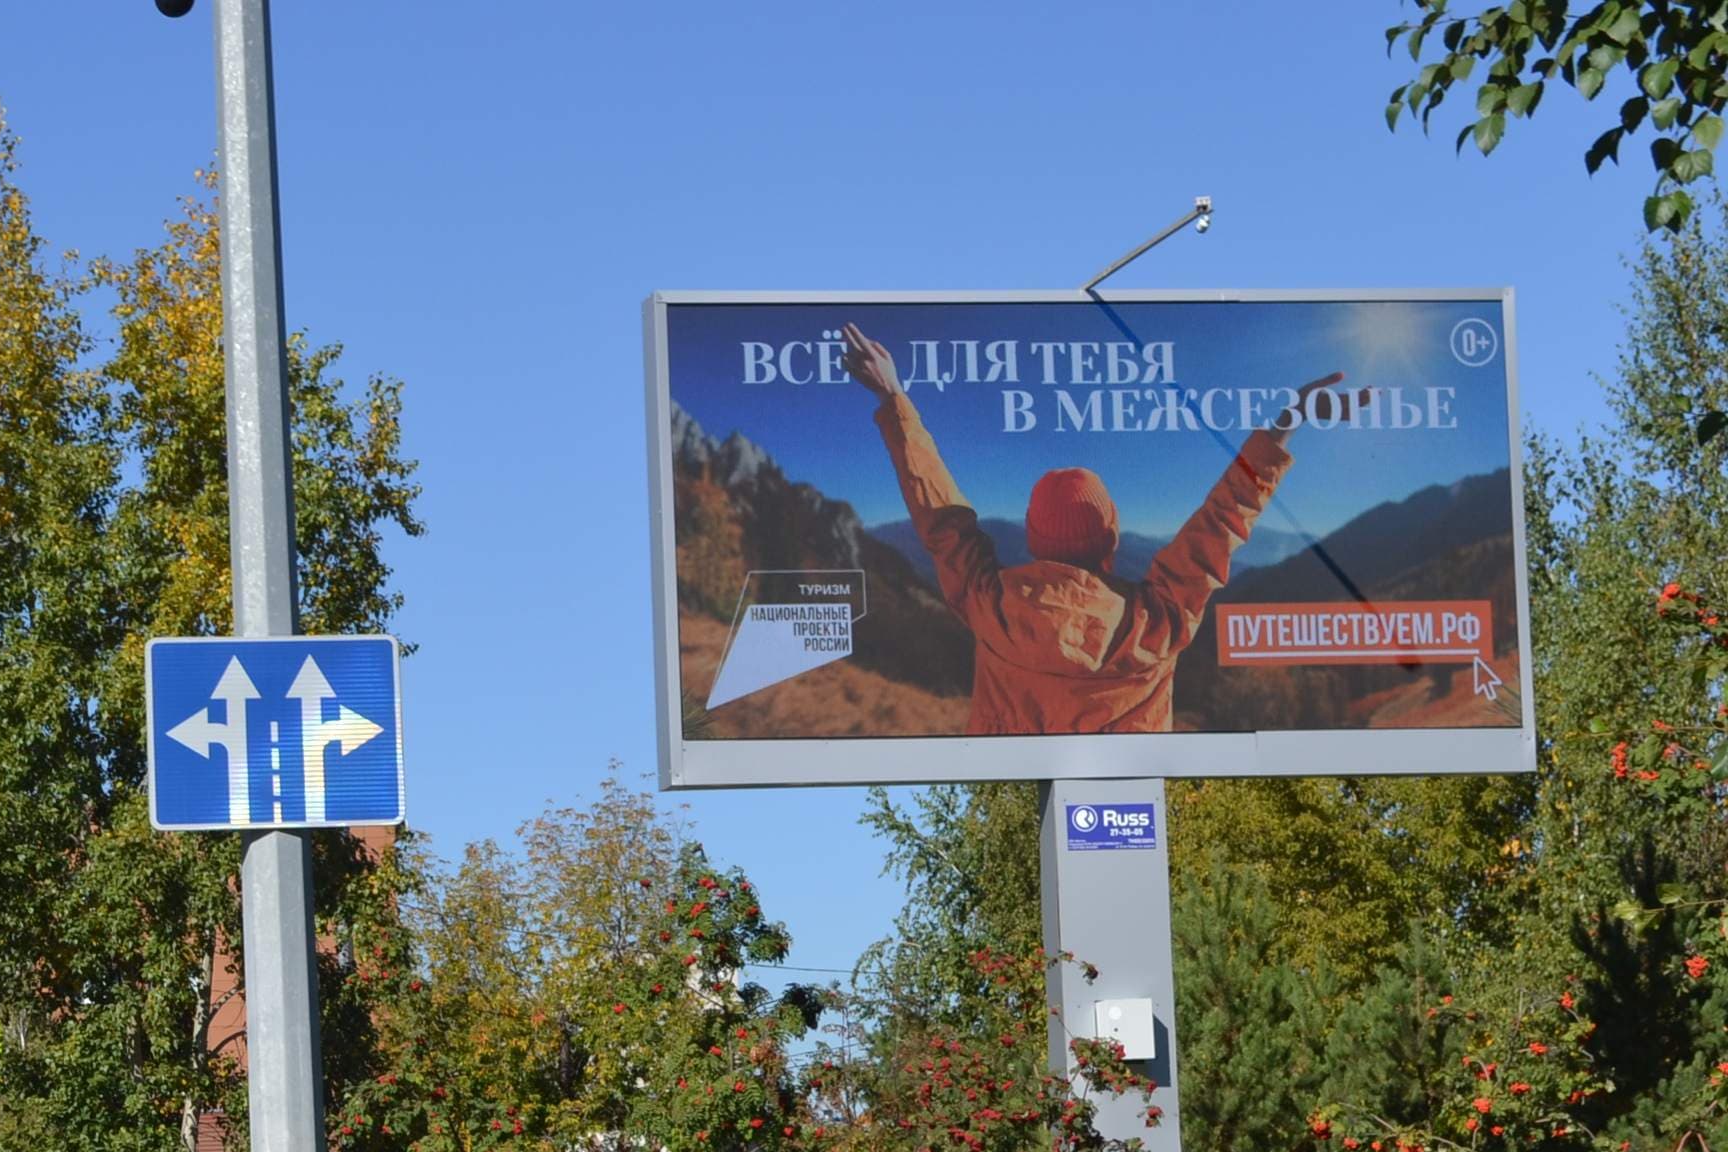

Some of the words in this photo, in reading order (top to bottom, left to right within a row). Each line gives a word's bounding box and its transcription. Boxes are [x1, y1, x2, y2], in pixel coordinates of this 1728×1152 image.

[1462, 329, 1490, 357] 0+
[741, 329, 851, 385] ВСЁ
[903, 340, 1022, 392] ДЛЯ
[1030, 340, 1177, 385] ТЕБЯ
[1002, 389, 1037, 433] В
[1055, 386, 1458, 433] МЕЖСЕЗОНЬЕ
[798, 583, 851, 596] ТУРИЗМ
[750, 605, 849, 622] НАЦИОНАЛЬНЫЕ
[793, 622, 849, 637] ПРОЕКТЫ
[1227, 612, 1481, 648] ПУТЕШЕСТВУЕМ.РФ
[804, 637, 850, 652] РОССИИ
